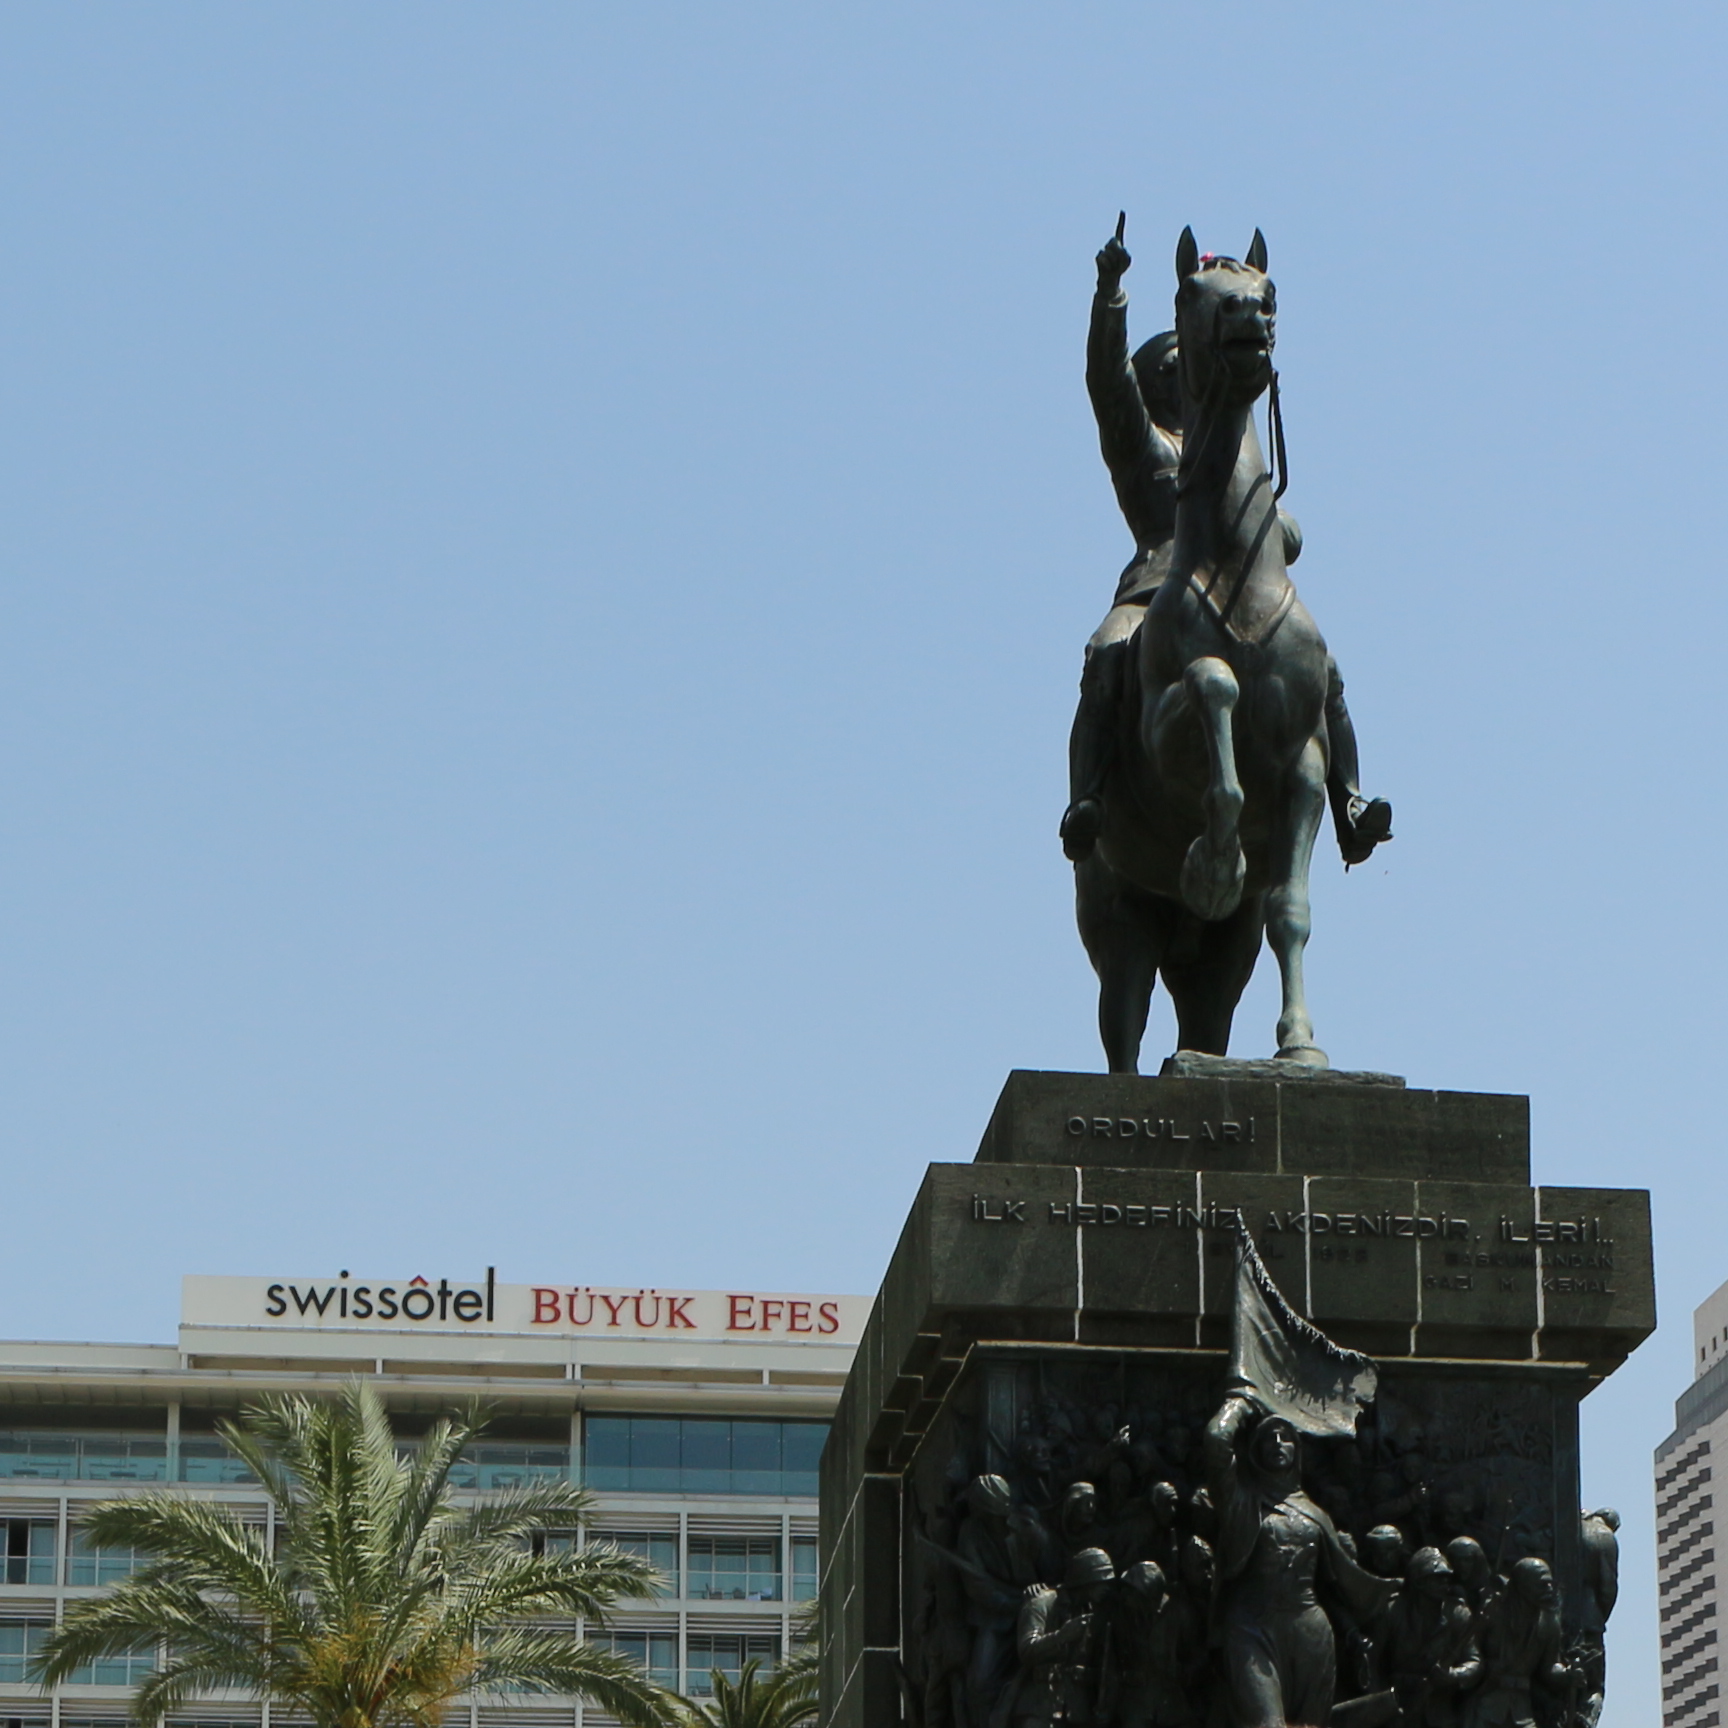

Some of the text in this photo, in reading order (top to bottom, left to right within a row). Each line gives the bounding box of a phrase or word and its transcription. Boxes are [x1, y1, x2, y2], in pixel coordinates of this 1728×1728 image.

[1066, 1115, 1256, 1143] ORDULAR!
[971, 1193, 1026, 1221] İLK
[1048, 1200, 1238, 1229] HEDEFİNİZ
[265, 1265, 840, 1335] swissôtel BÜYÜK EFES
[1542, 1275, 1617, 1294] KEMAL
